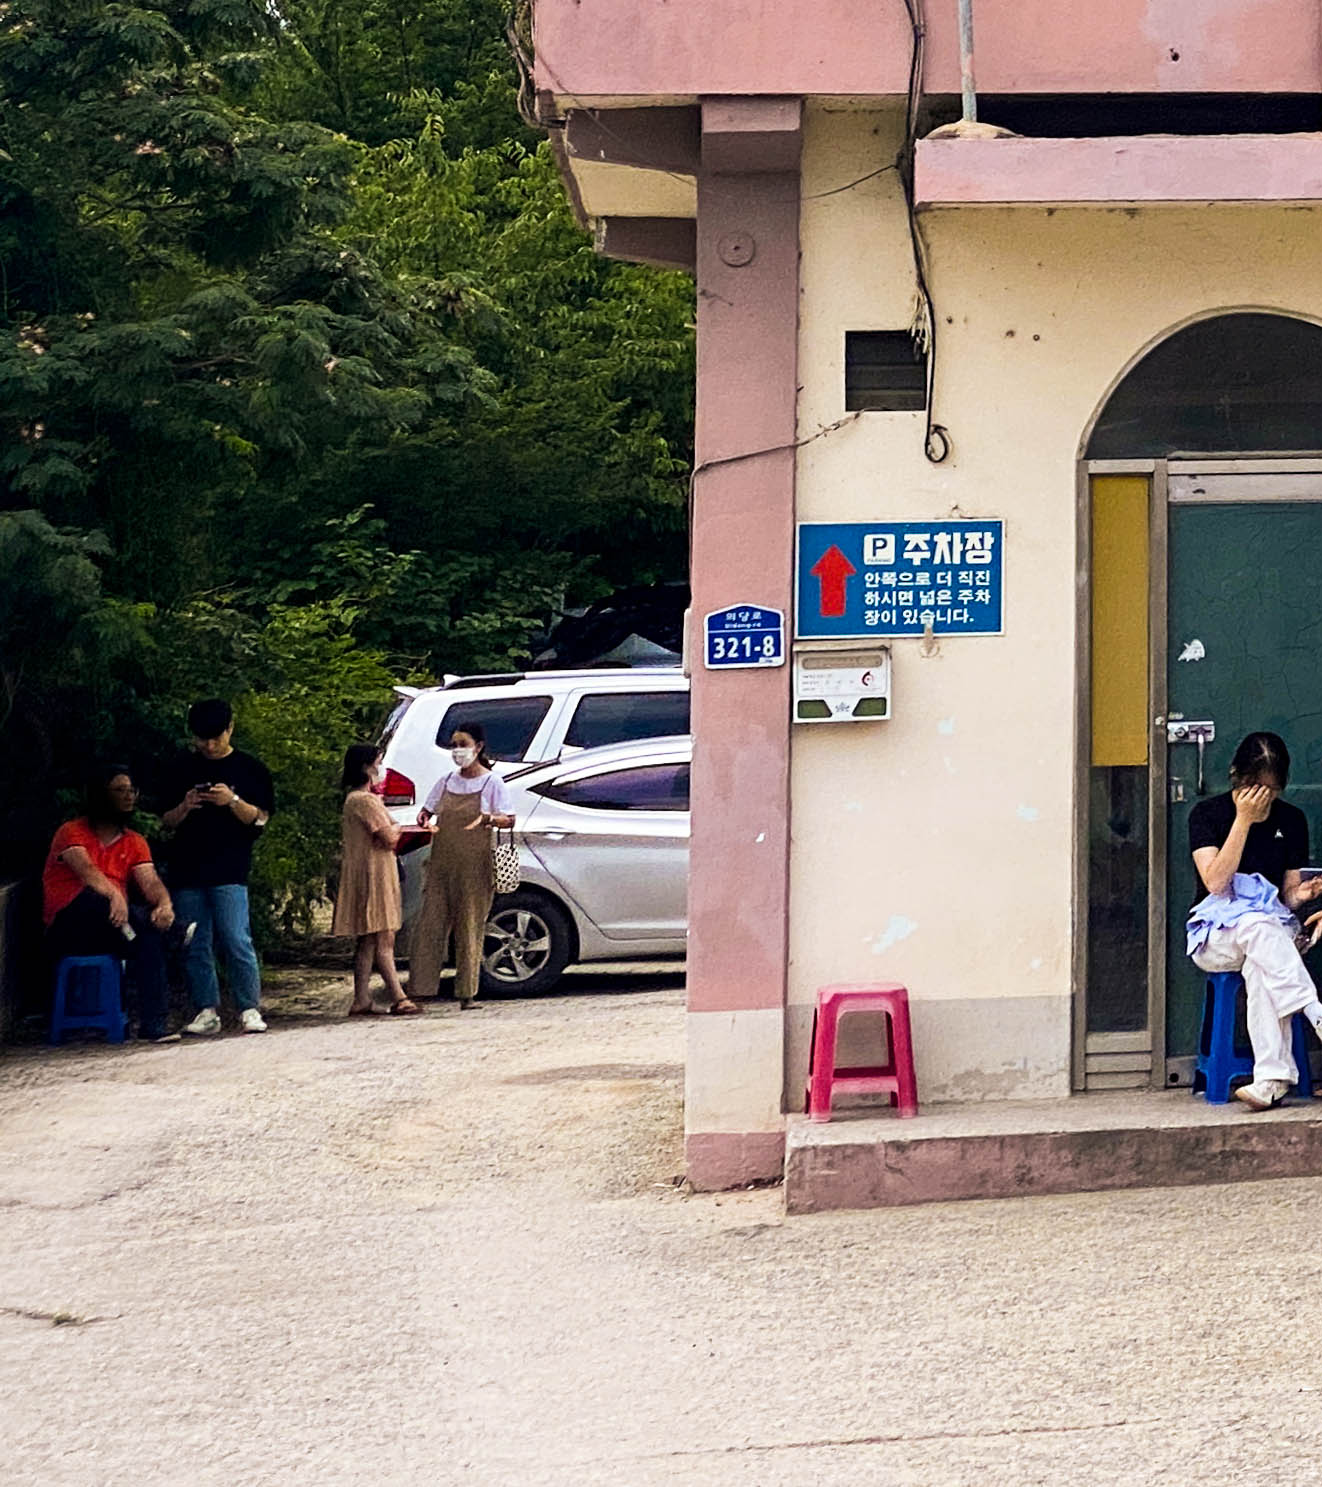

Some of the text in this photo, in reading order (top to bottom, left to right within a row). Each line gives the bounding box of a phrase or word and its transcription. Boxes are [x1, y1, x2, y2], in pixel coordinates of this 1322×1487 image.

[903, 531, 995, 565] 주차장
[864, 570, 990, 588] 안쪽으로 더 직진
[864, 588, 991, 607] 하시면 넓은 주차
[864, 608, 975, 626] 장이 있습니다.
[713, 635, 775, 659] 321-8
